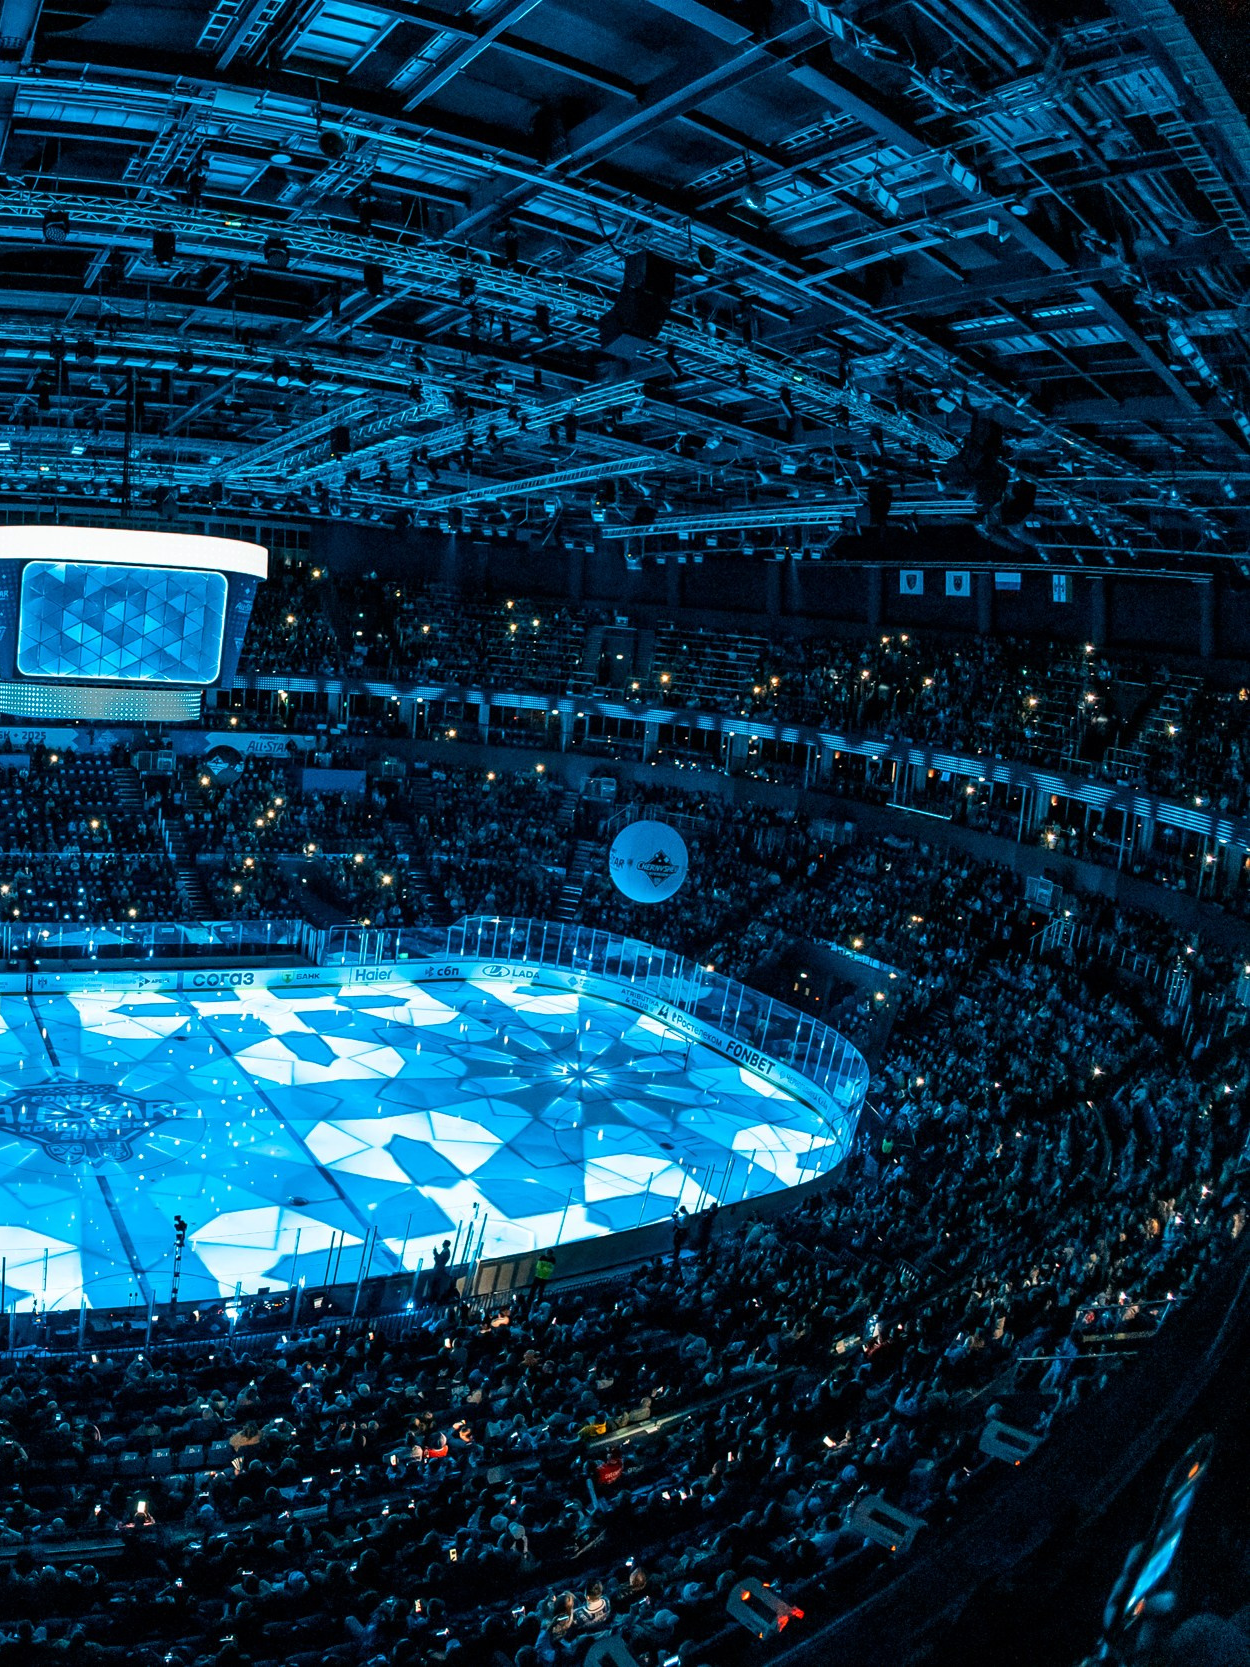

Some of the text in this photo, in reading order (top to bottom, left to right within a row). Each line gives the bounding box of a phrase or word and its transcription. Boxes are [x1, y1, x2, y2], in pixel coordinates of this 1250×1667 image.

[22, 731, 46, 740] 2025
[355, 968, 392, 981] Haier
[512, 969, 540, 979] LADA
[631, 1000, 649, 1010] CLUB
[677, 1015, 722, 1047] Ростелеком
[725, 1040, 776, 1075] FONBET
[31, 1094, 103, 1103] FONBET
